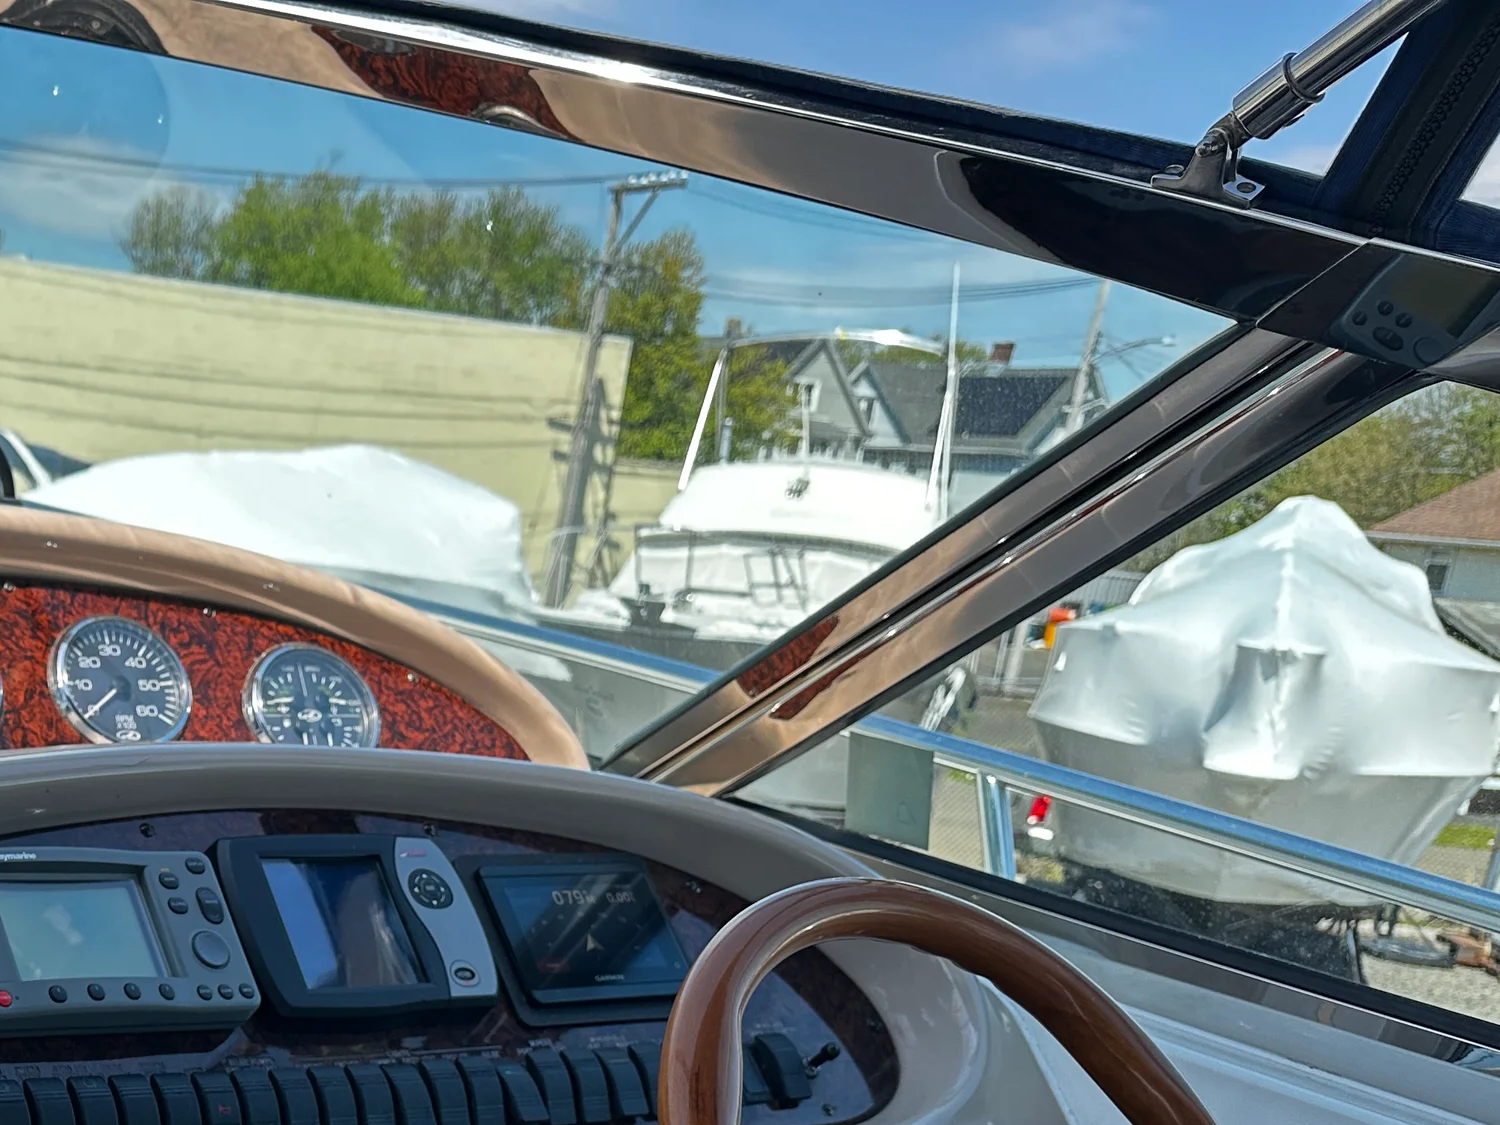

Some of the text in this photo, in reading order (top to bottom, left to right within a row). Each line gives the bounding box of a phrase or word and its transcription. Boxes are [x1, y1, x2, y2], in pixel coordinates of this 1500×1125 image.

[98, 645, 121, 656] 30
[78, 657, 100, 668] 20
[125, 657, 146, 668] 40
[75, 679, 92, 690] 10
[138, 679, 160, 691] 50
